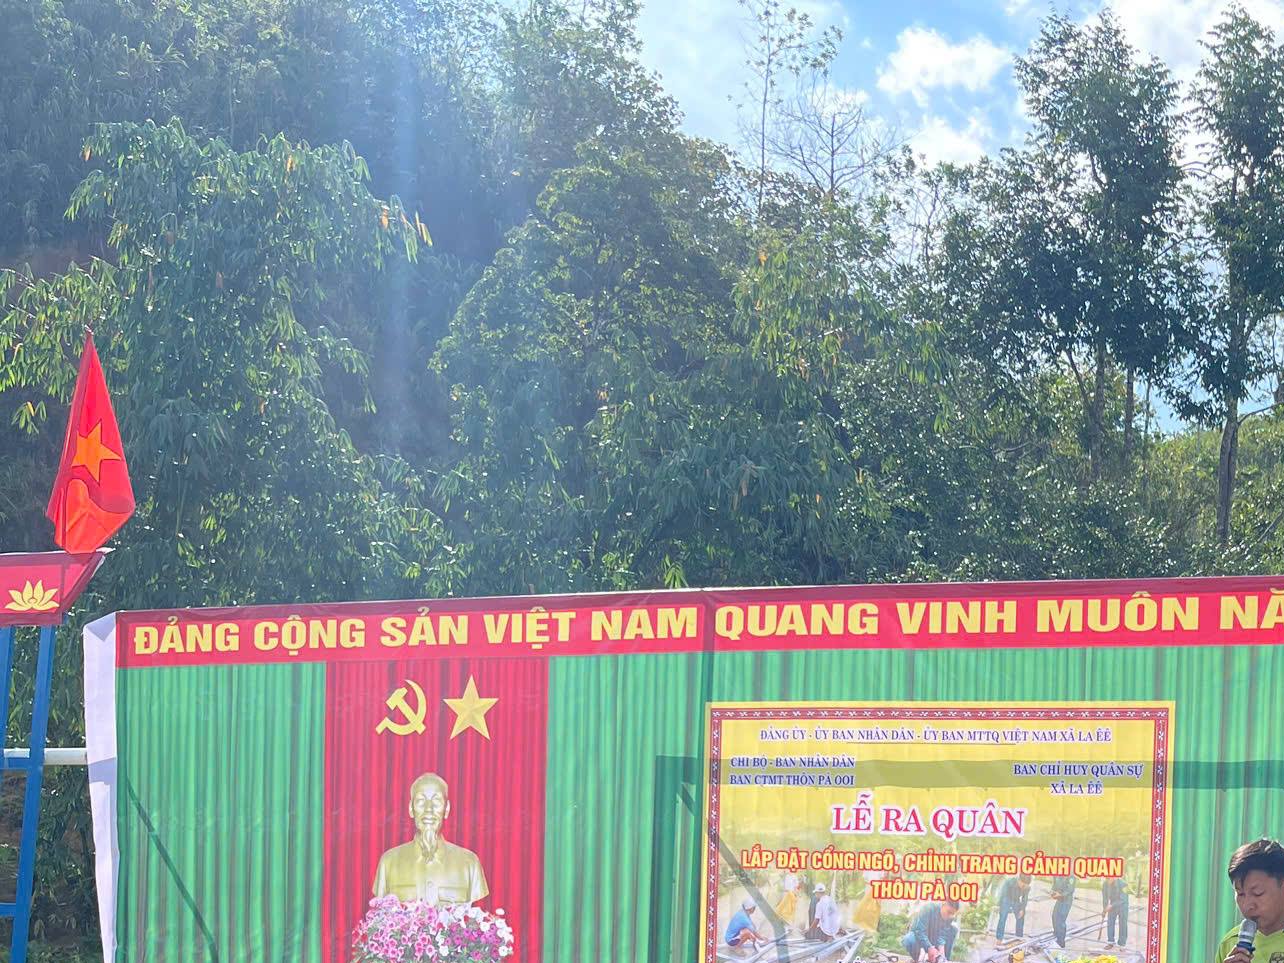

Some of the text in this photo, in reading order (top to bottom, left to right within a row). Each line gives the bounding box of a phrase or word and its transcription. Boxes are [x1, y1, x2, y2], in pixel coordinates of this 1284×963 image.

[134, 615, 240, 655] ĐẢNG
[253, 615, 367, 657] CỘNG
[380, 605, 468, 648] SẢN
[485, 606, 576, 650] VIỆT
[591, 605, 698, 641] NAM
[715, 601, 880, 641] QUANG
[895, 600, 1014, 635] VINH
[1036, 590, 1199, 633] MUÔN
[832, 729, 854, 740] BAN
[858, 727, 888, 741] NHÂN
[891, 727, 915, 741] DÂN
[941, 730, 965, 741] BAN
[967, 731, 999, 743] MTTQ
[1003, 729, 1030, 744] VIỆT
[1032, 731, 1058, 742] NAM
[1078, 731, 1093, 742] LA
[731, 757, 749, 768] CHI
[752, 755, 767, 770] BỘ
[775, 757, 796, 768] BAN
[799, 755, 829, 768] NHÂN
[832, 754, 855, 768] DÂN
[1014, 764, 1037, 775] BAN
[1064, 764, 1088, 776] HUY
[1091, 761, 1124, 777] QUÂN
[1127, 763, 1144, 778] SỰ
[730, 775, 751, 785] BAN
[786, 772, 815, 786] THÔN
[834, 775, 855, 786] OOI
[1069, 783, 1084, 794] LA
[832, 793, 1025, 839] LỄ RA QUÂN
[742, 844, 1123, 878] LẮP ĐẶT CỔNG NGÕ, CHỈNH TRANG CẢNH QUAN
[871, 878, 978, 903] THÔN PÀ OOI
